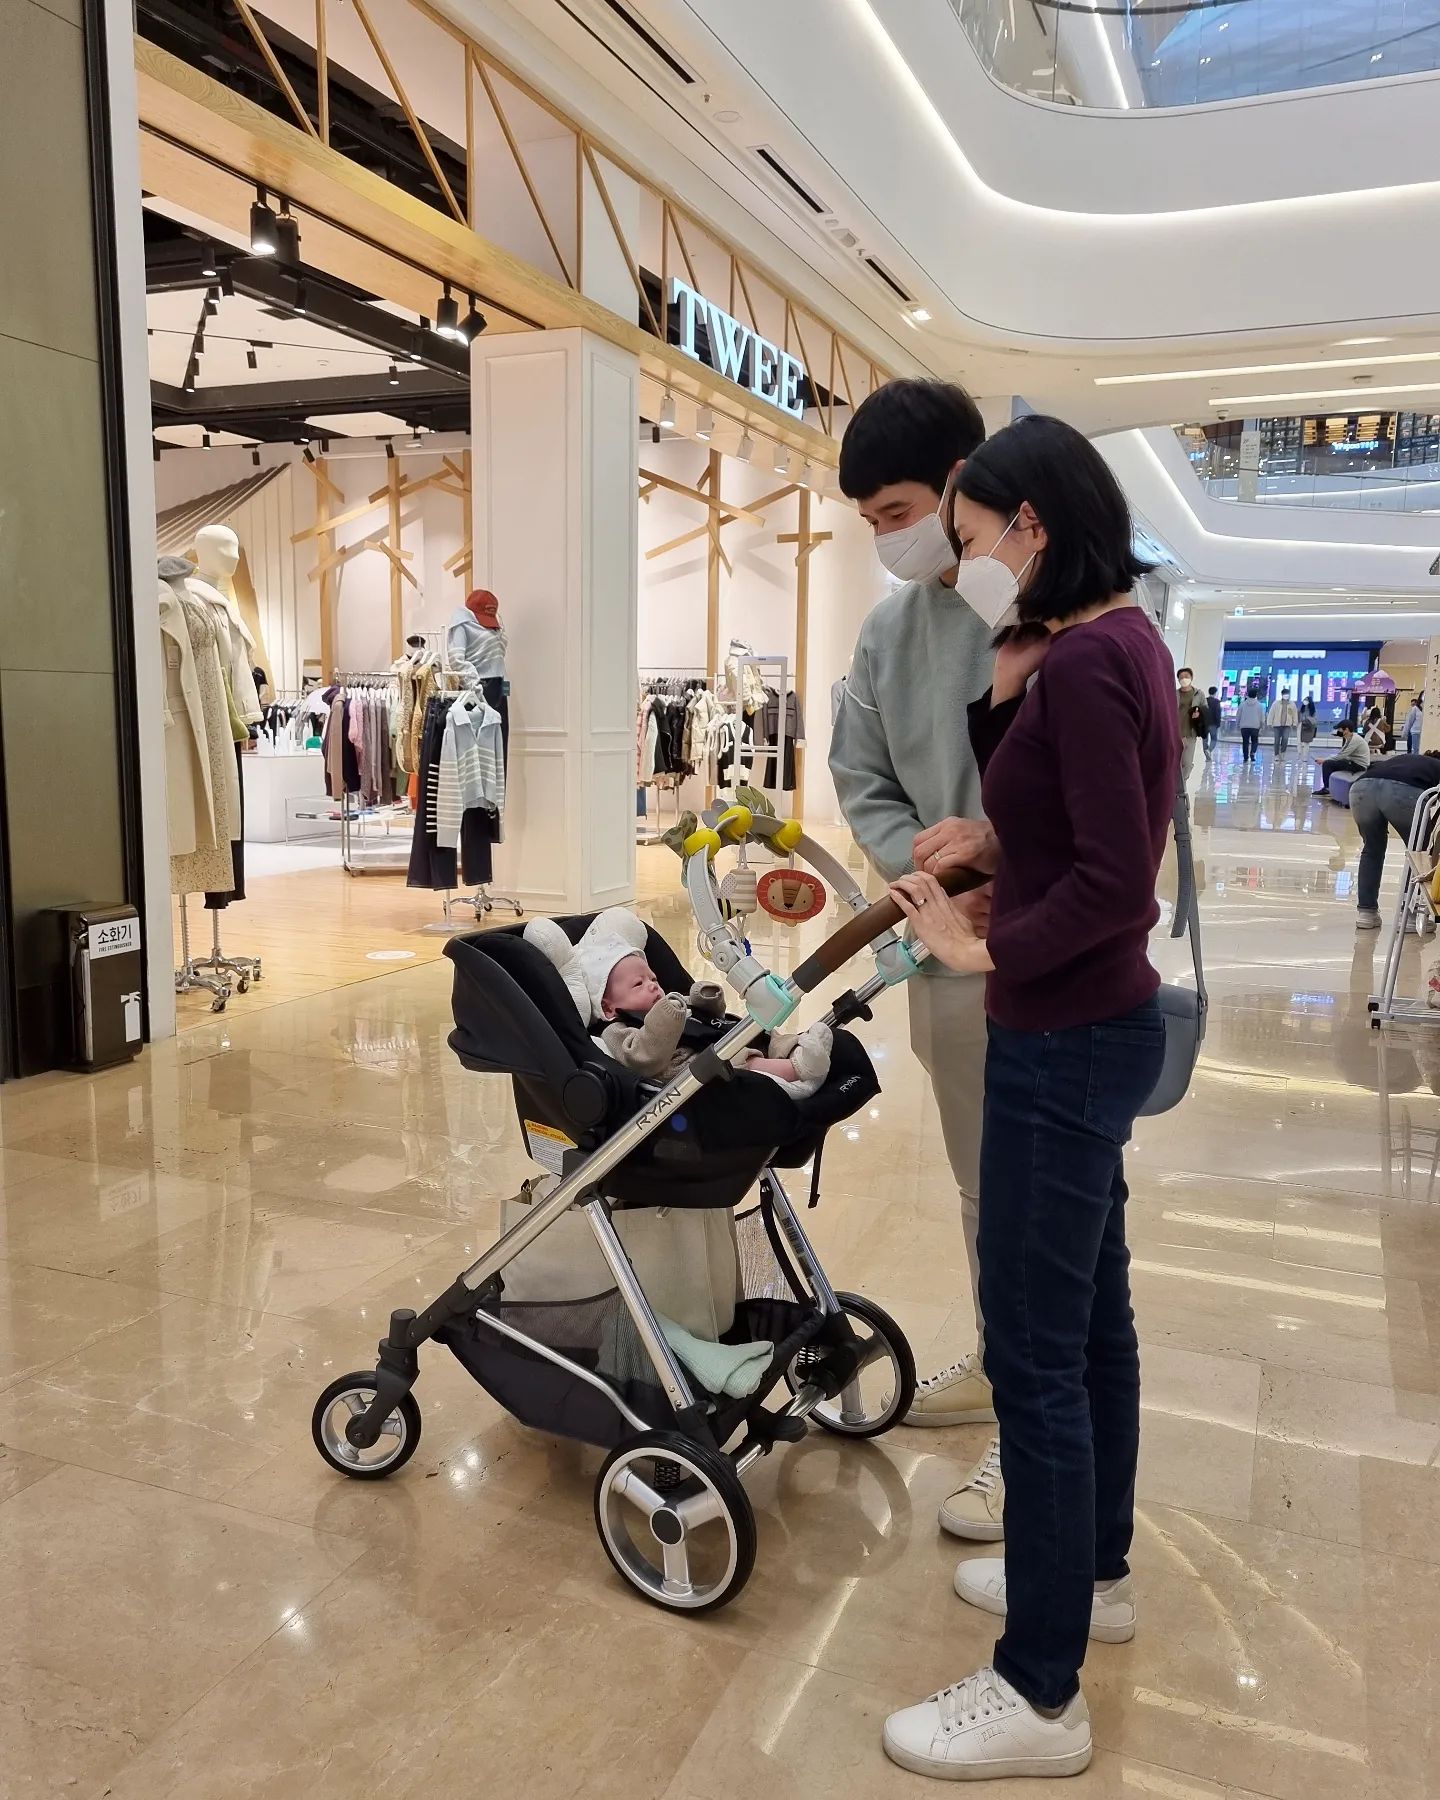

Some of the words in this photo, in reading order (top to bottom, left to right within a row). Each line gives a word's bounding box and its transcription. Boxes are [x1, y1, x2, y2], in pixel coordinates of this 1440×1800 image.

[670, 277, 803, 420] TWEE
[98, 924, 131, 944] 소화기
[839, 1075, 861, 1093] RYAN
[635, 1086, 682, 1131] RYAN
